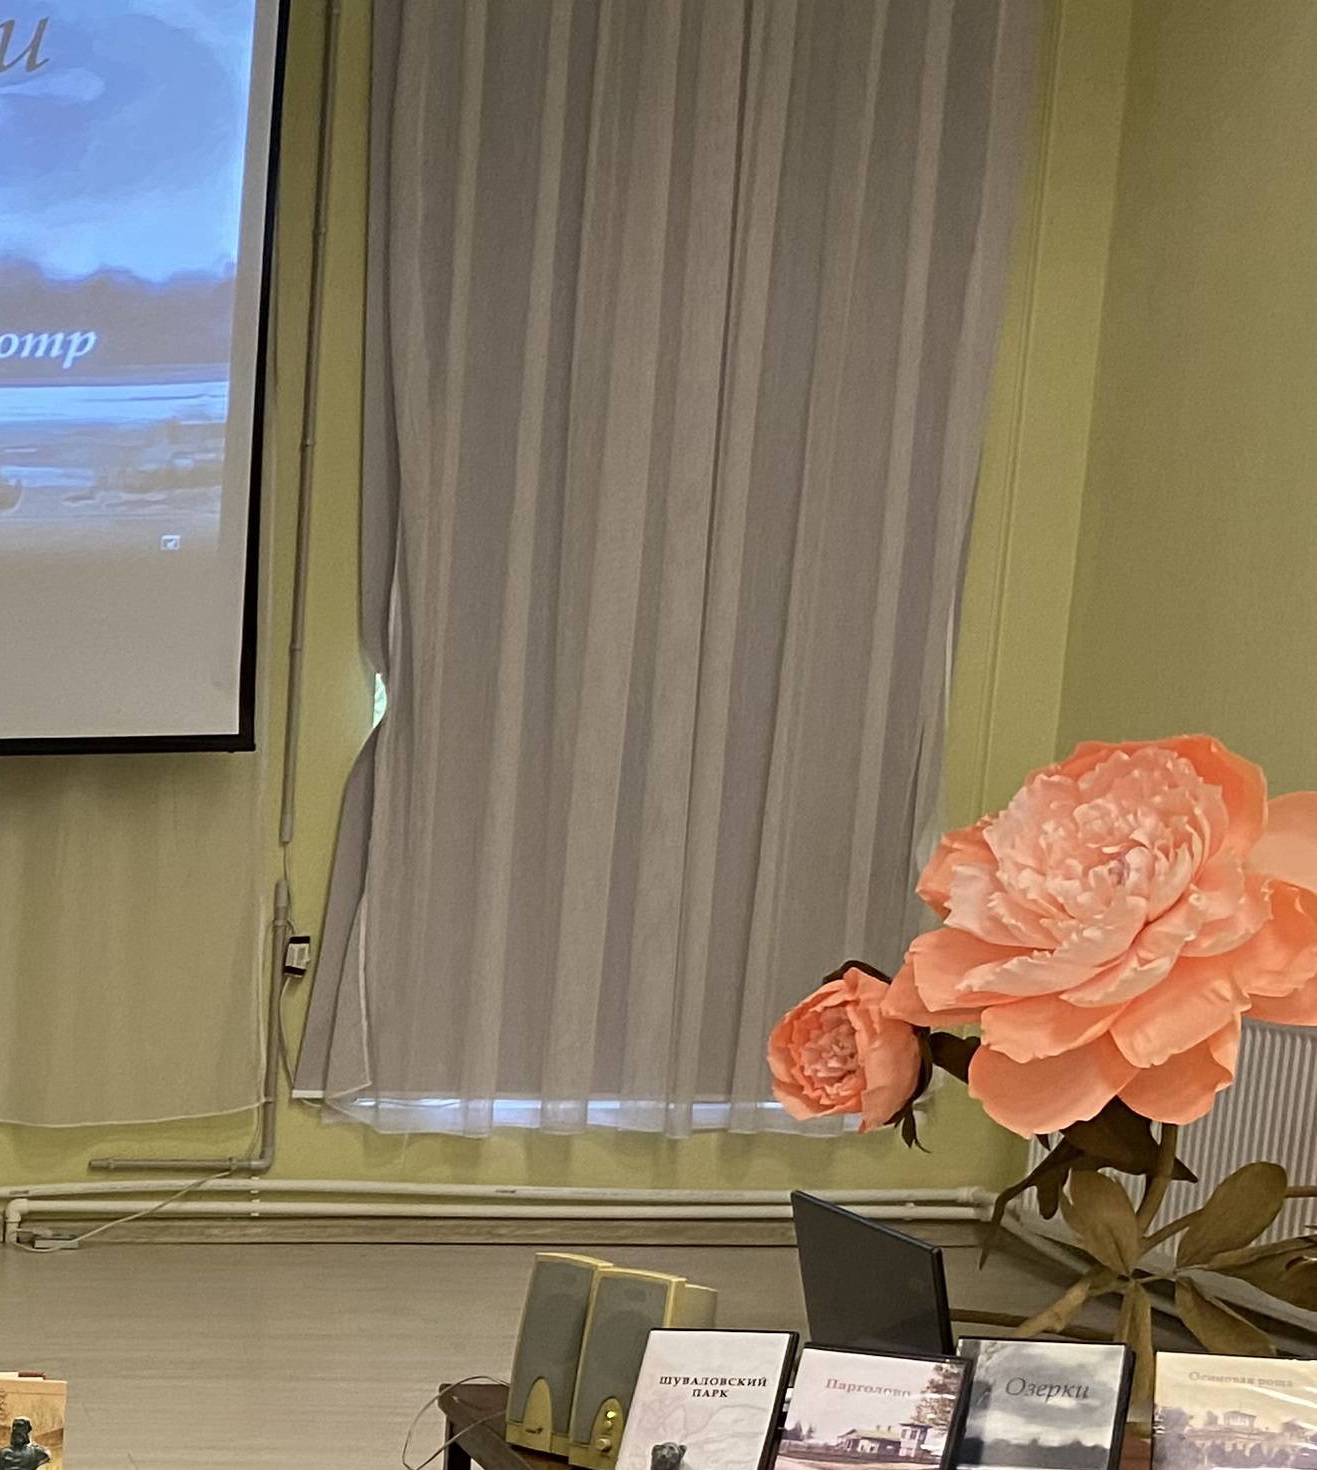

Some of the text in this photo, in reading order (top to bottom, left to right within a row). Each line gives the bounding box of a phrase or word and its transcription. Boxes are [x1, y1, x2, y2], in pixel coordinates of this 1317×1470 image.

[659, 1375, 768, 1388] ШУВАЛОВСКИЙ
[825, 1378, 912, 1398] Парголово
[1005, 1376, 1092, 1402] Озерки
[692, 1388, 729, 1398] ПАРК
